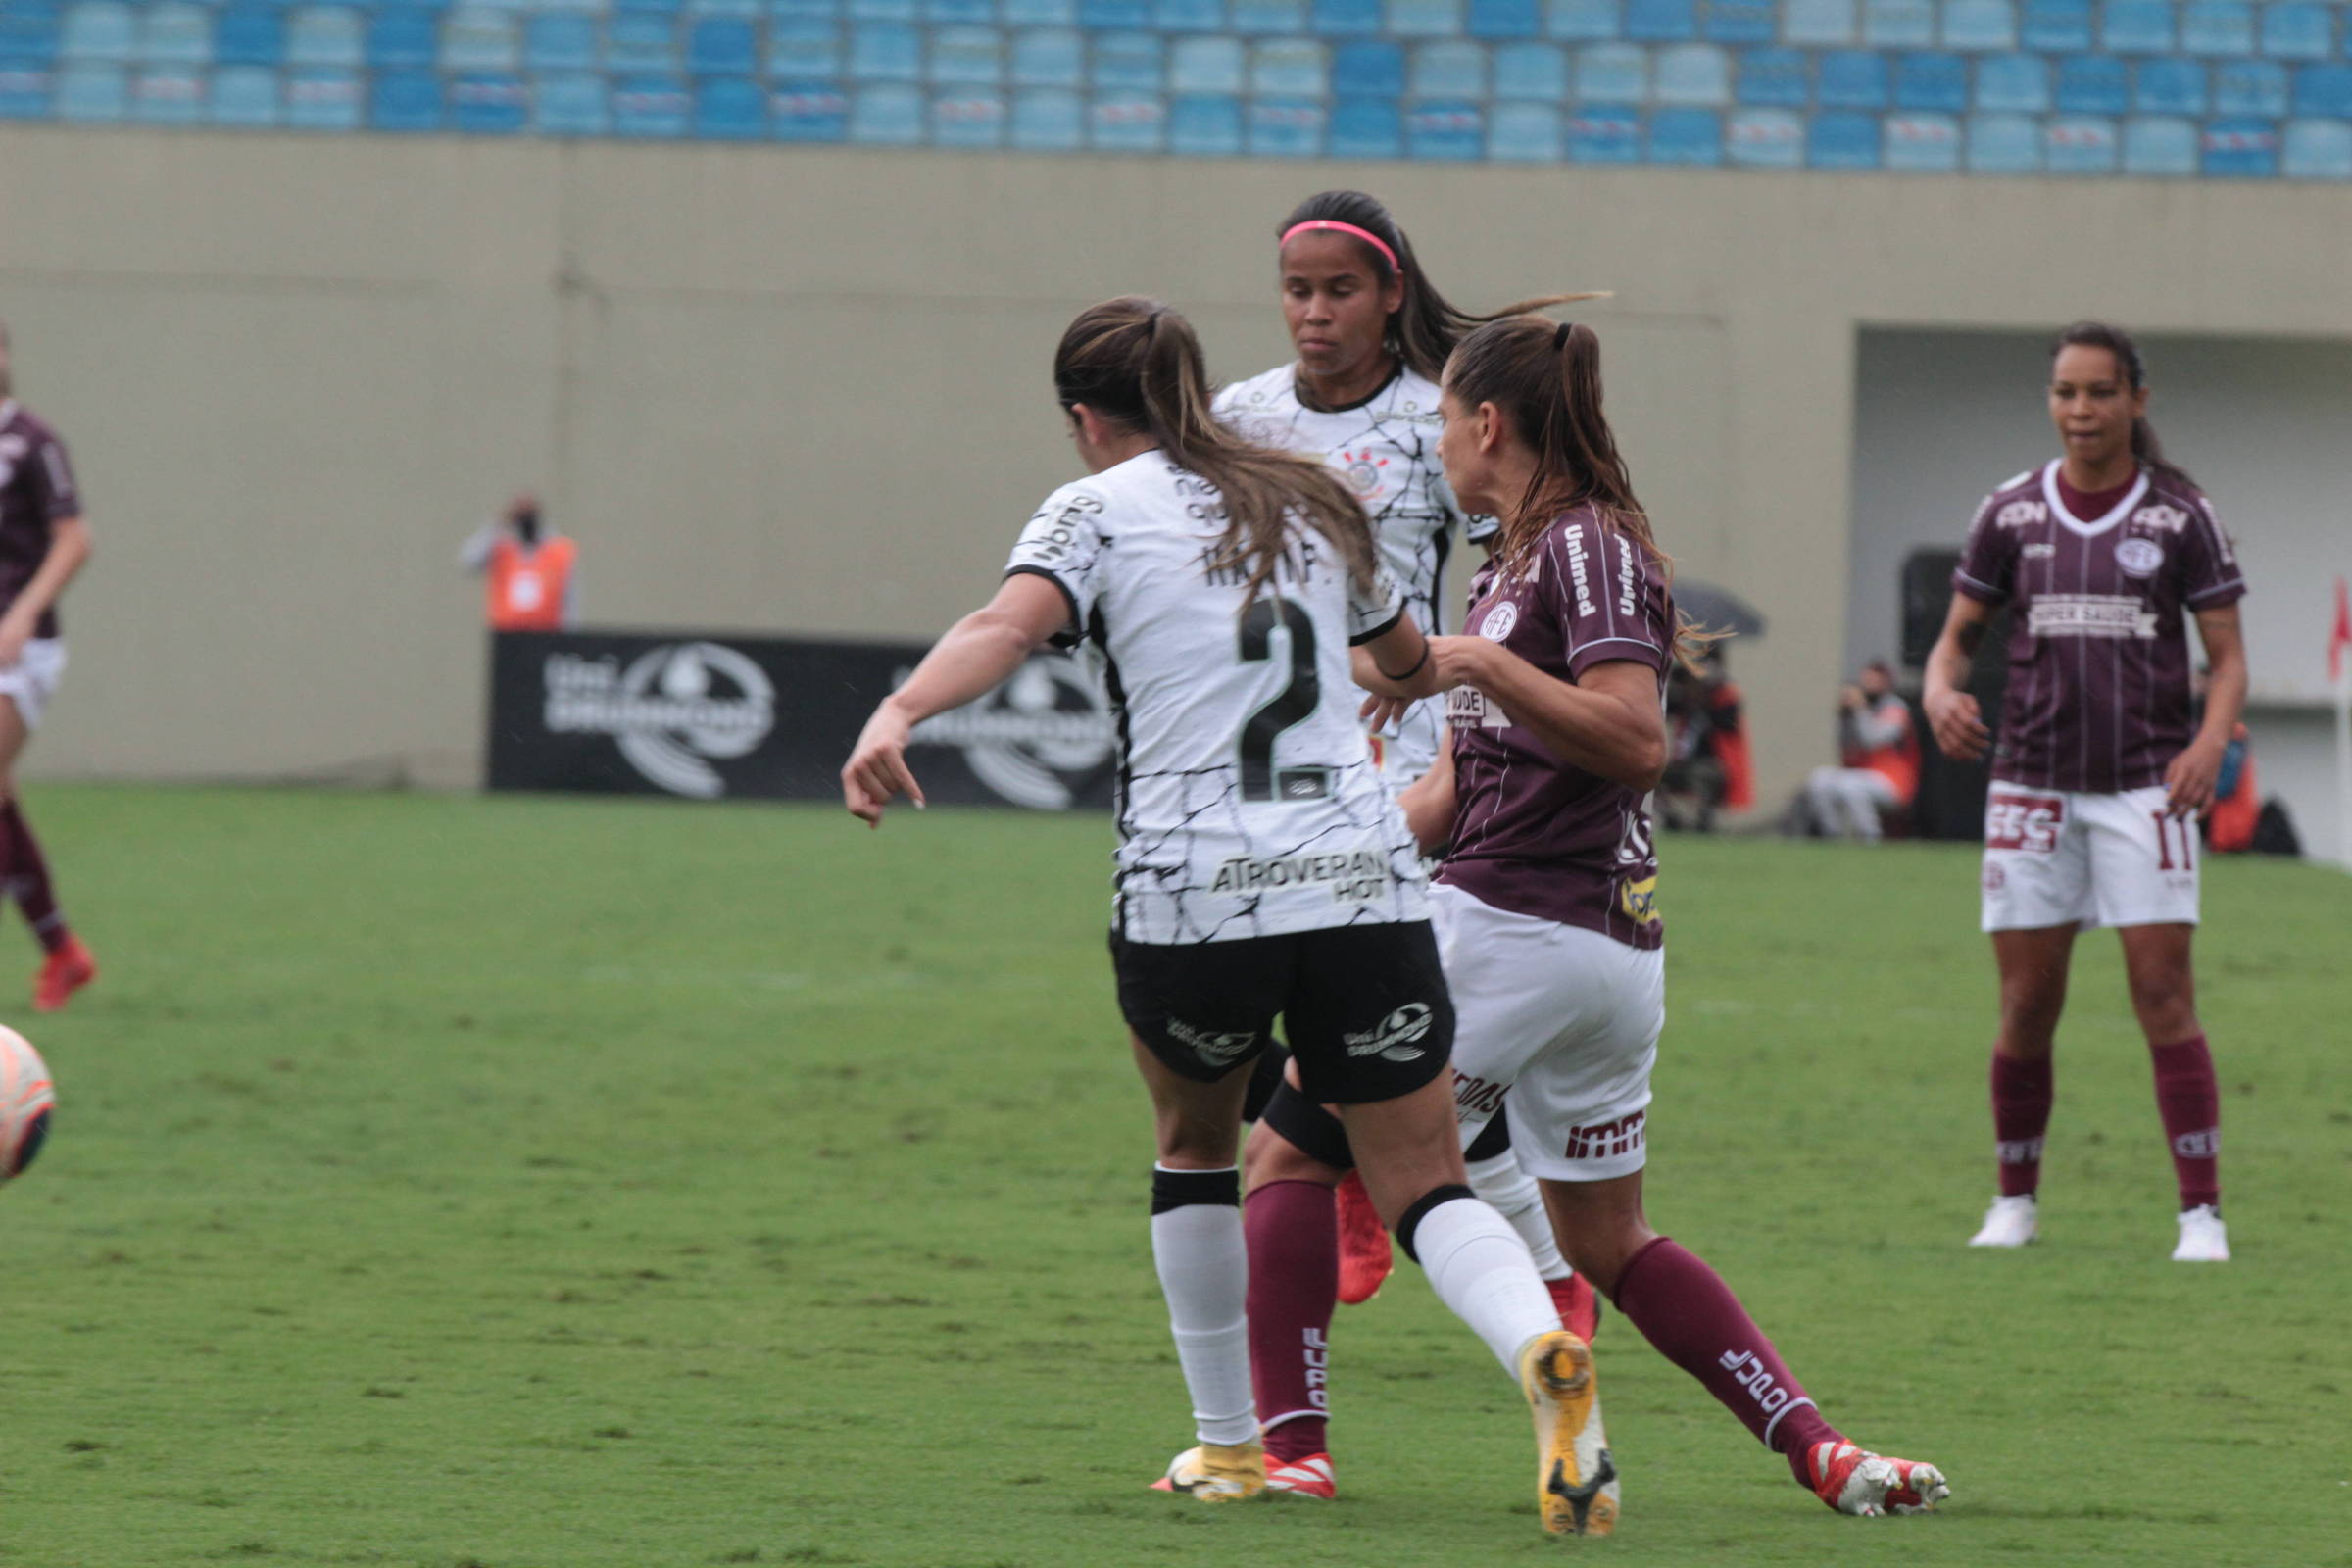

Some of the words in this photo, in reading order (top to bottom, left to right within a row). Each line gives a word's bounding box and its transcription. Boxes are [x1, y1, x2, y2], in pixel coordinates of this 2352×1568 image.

[1564, 524, 1597, 618] Unimed
[1239, 597, 1320, 802] 2
[1210, 852, 1388, 893] ATROVERAN
[1333, 878, 1384, 902] HOT
